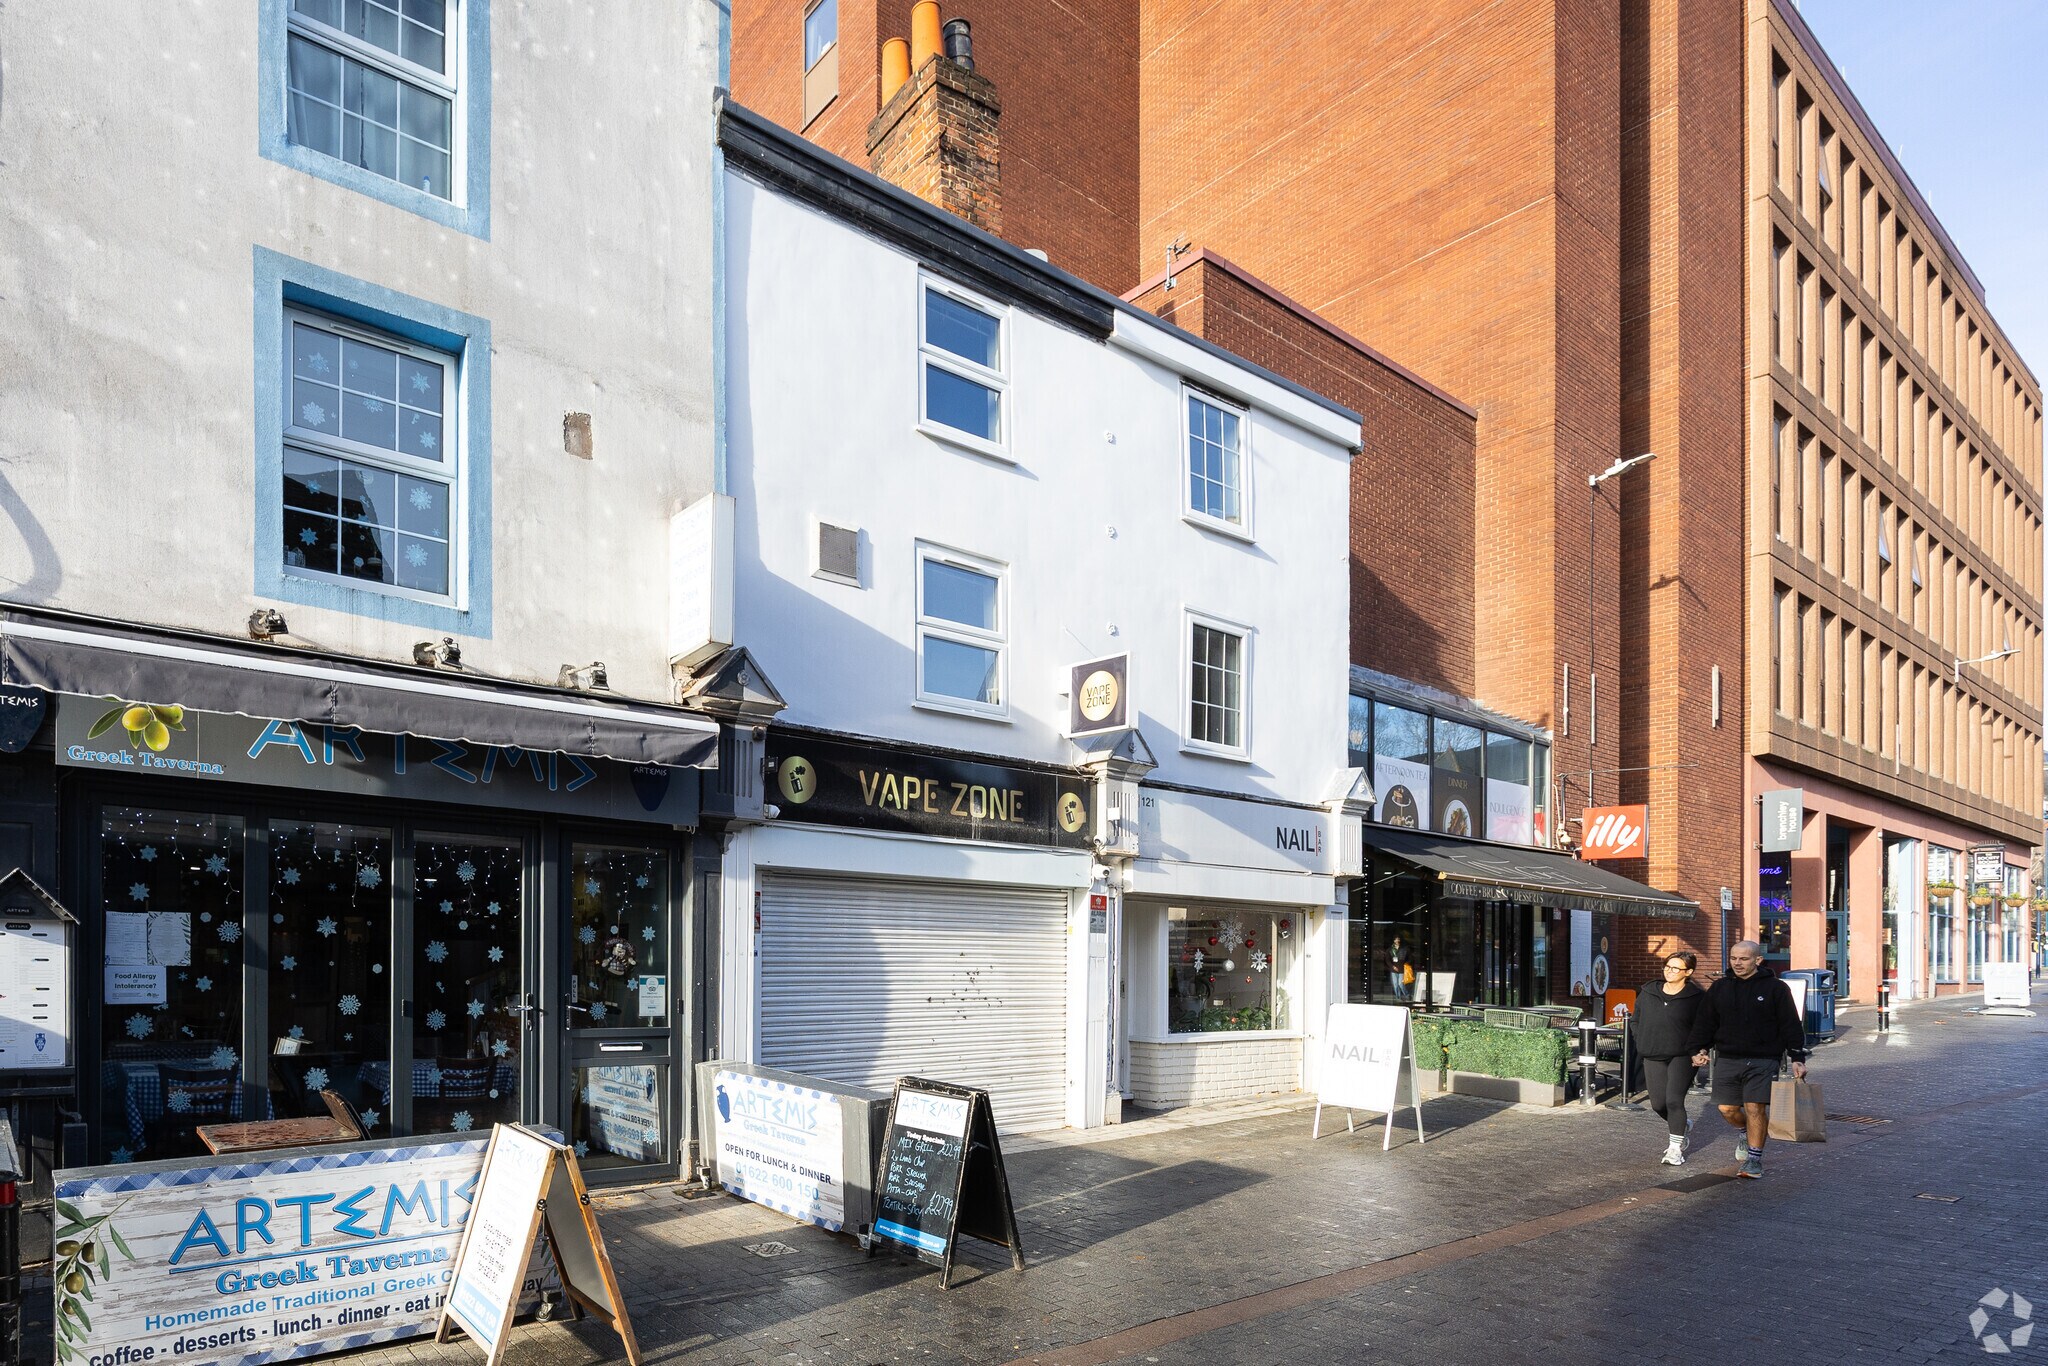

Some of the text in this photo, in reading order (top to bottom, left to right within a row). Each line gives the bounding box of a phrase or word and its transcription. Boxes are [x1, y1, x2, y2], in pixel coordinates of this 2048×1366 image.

[1086, 683, 1110, 697] VAPE
[1086, 694, 1110, 708] ZONE
[67, 745, 225, 775] Greek Taverna
[633, 766, 668, 777] ARTEMIS
[1375, 762, 1428, 780] AFTERNOON TEA
[858, 769, 1024, 823] VAPE ZONE
[1448, 778, 1468, 789] DINNER
[1141, 797, 1155, 808] 121
[1777, 801, 1789, 841] brenchley
[1788, 807, 1797, 833] house
[1276, 826, 1315, 853] NAIL
[1585, 813, 1642, 855] illy
[1450, 882, 1478, 897] COFFEE
[1514, 890, 1544, 904] DESSERTS
[1331, 1043, 1380, 1064] NAIL
[733, 1089, 818, 1130] ARTEMIS
[900, 1096, 964, 1120] ARTEMIS
[743, 1119, 807, 1146] Greek Taverna
[898, 1137, 914, 1151] MIX
[915, 1140, 935, 1153] GRILL
[906, 1130, 946, 1145] Today Specials
[725, 1142, 744, 1156] OPEN
[746, 1150, 761, 1162] FOR
[762, 1154, 789, 1171] LUNCH
[791, 1164, 797, 1173] &
[799, 1166, 832, 1185] DINNER
[735, 1161, 769, 1184] 01622
[772, 1174, 793, 1192] 600
[798, 1183, 819, 1201] 150
[215, 1257, 320, 1295] Greek
[326, 1246, 450, 1278] Taverna
[145, 1298, 267, 1331] Homemade
[273, 1281, 375, 1311] Traditional
[383, 1274, 436, 1294] Greek
[89, 1345, 155, 1366] coffee
[173, 1325, 256, 1355] desserts
[273, 1313, 322, 1338] lunch
[337, 1303, 390, 1326] dinner
[405, 1296, 430, 1314] eat
